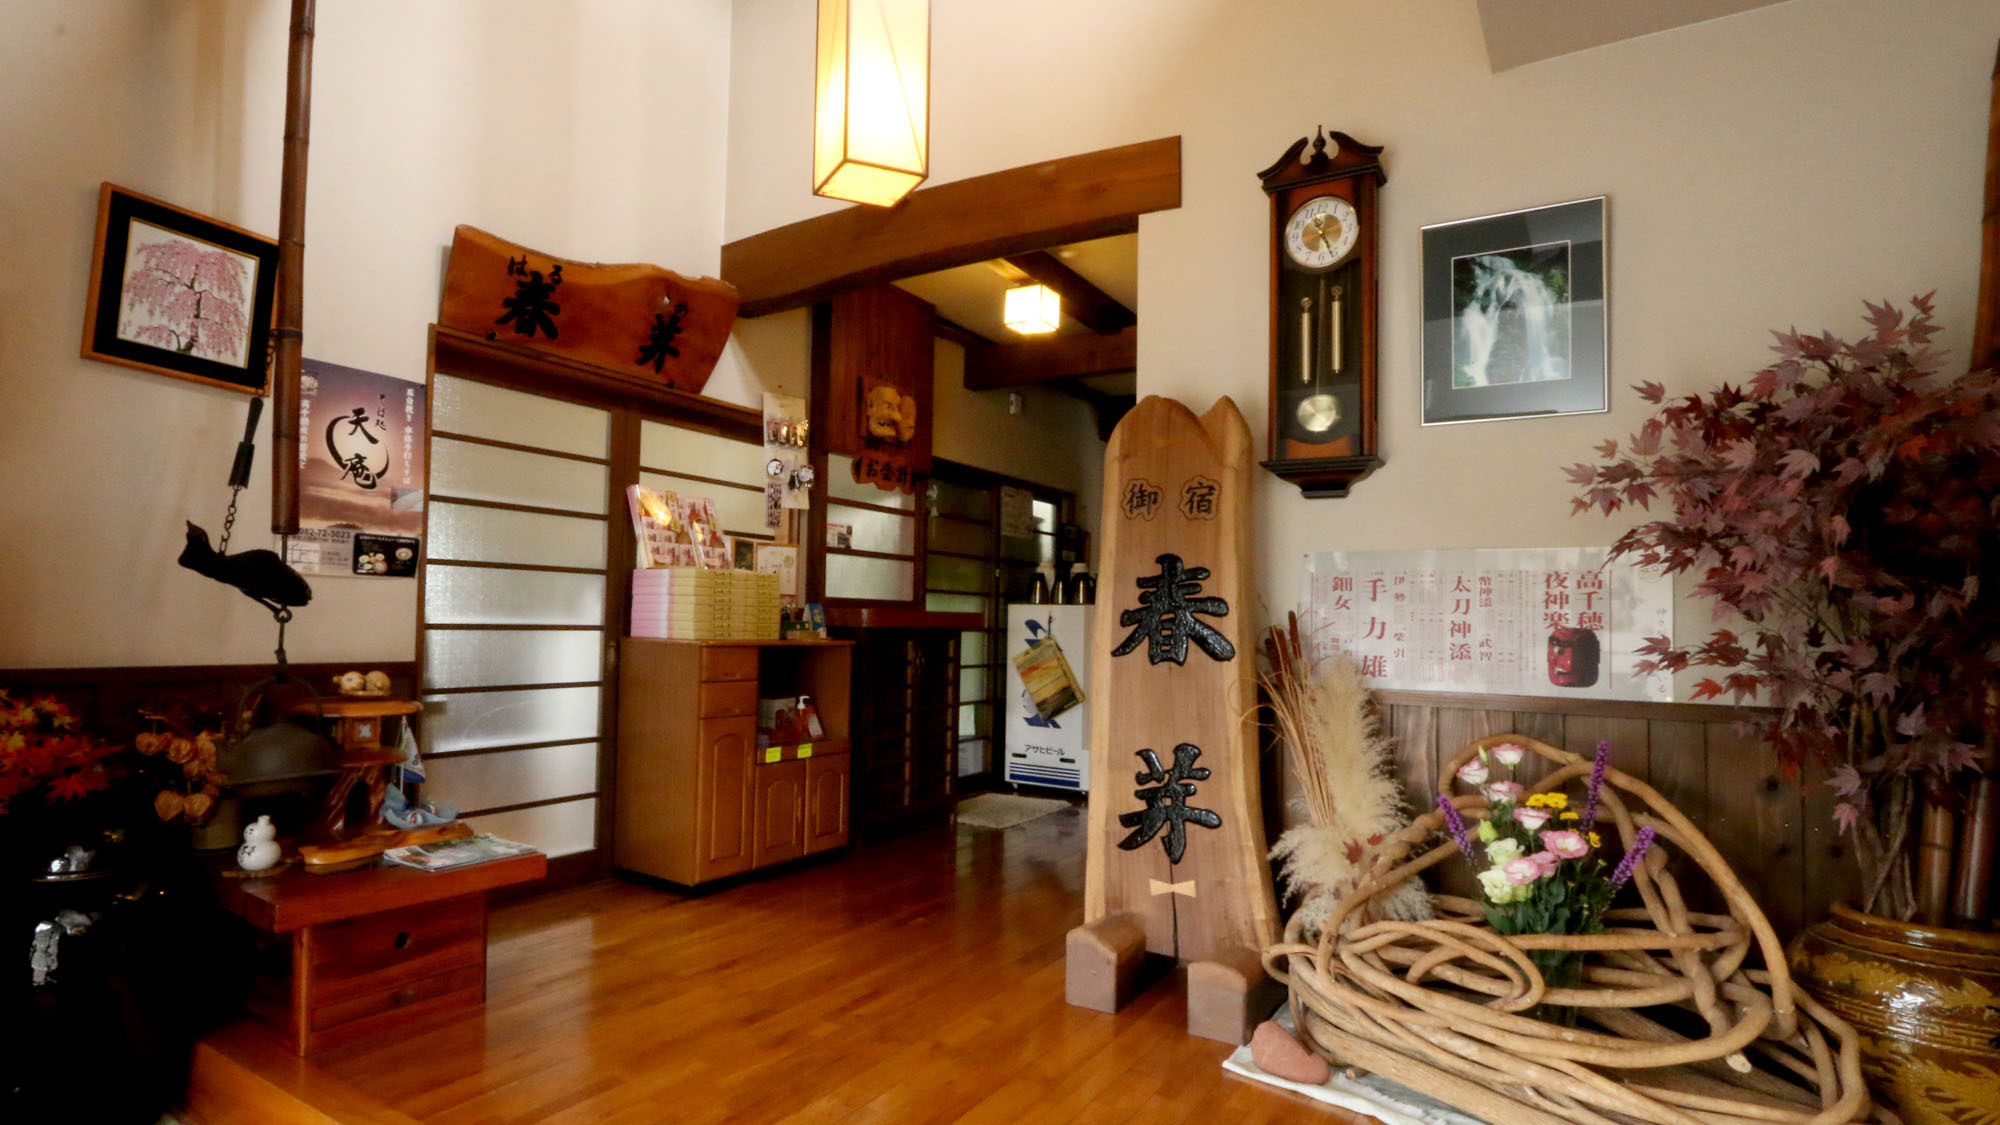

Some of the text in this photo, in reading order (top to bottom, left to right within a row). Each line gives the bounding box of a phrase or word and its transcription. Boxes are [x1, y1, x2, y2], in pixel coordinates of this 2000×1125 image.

[867, 459, 909, 486] お会計
[1127, 482, 1216, 515] 御宿
[1361, 577, 1388, 678] 手力雄
[1449, 575, 1472, 661] 太刀神添
[1544, 570, 1570, 630] 夜神楽
[1576, 570, 1604, 631] 高千穂
[1024, 744, 1065, 756] アサヒビール
